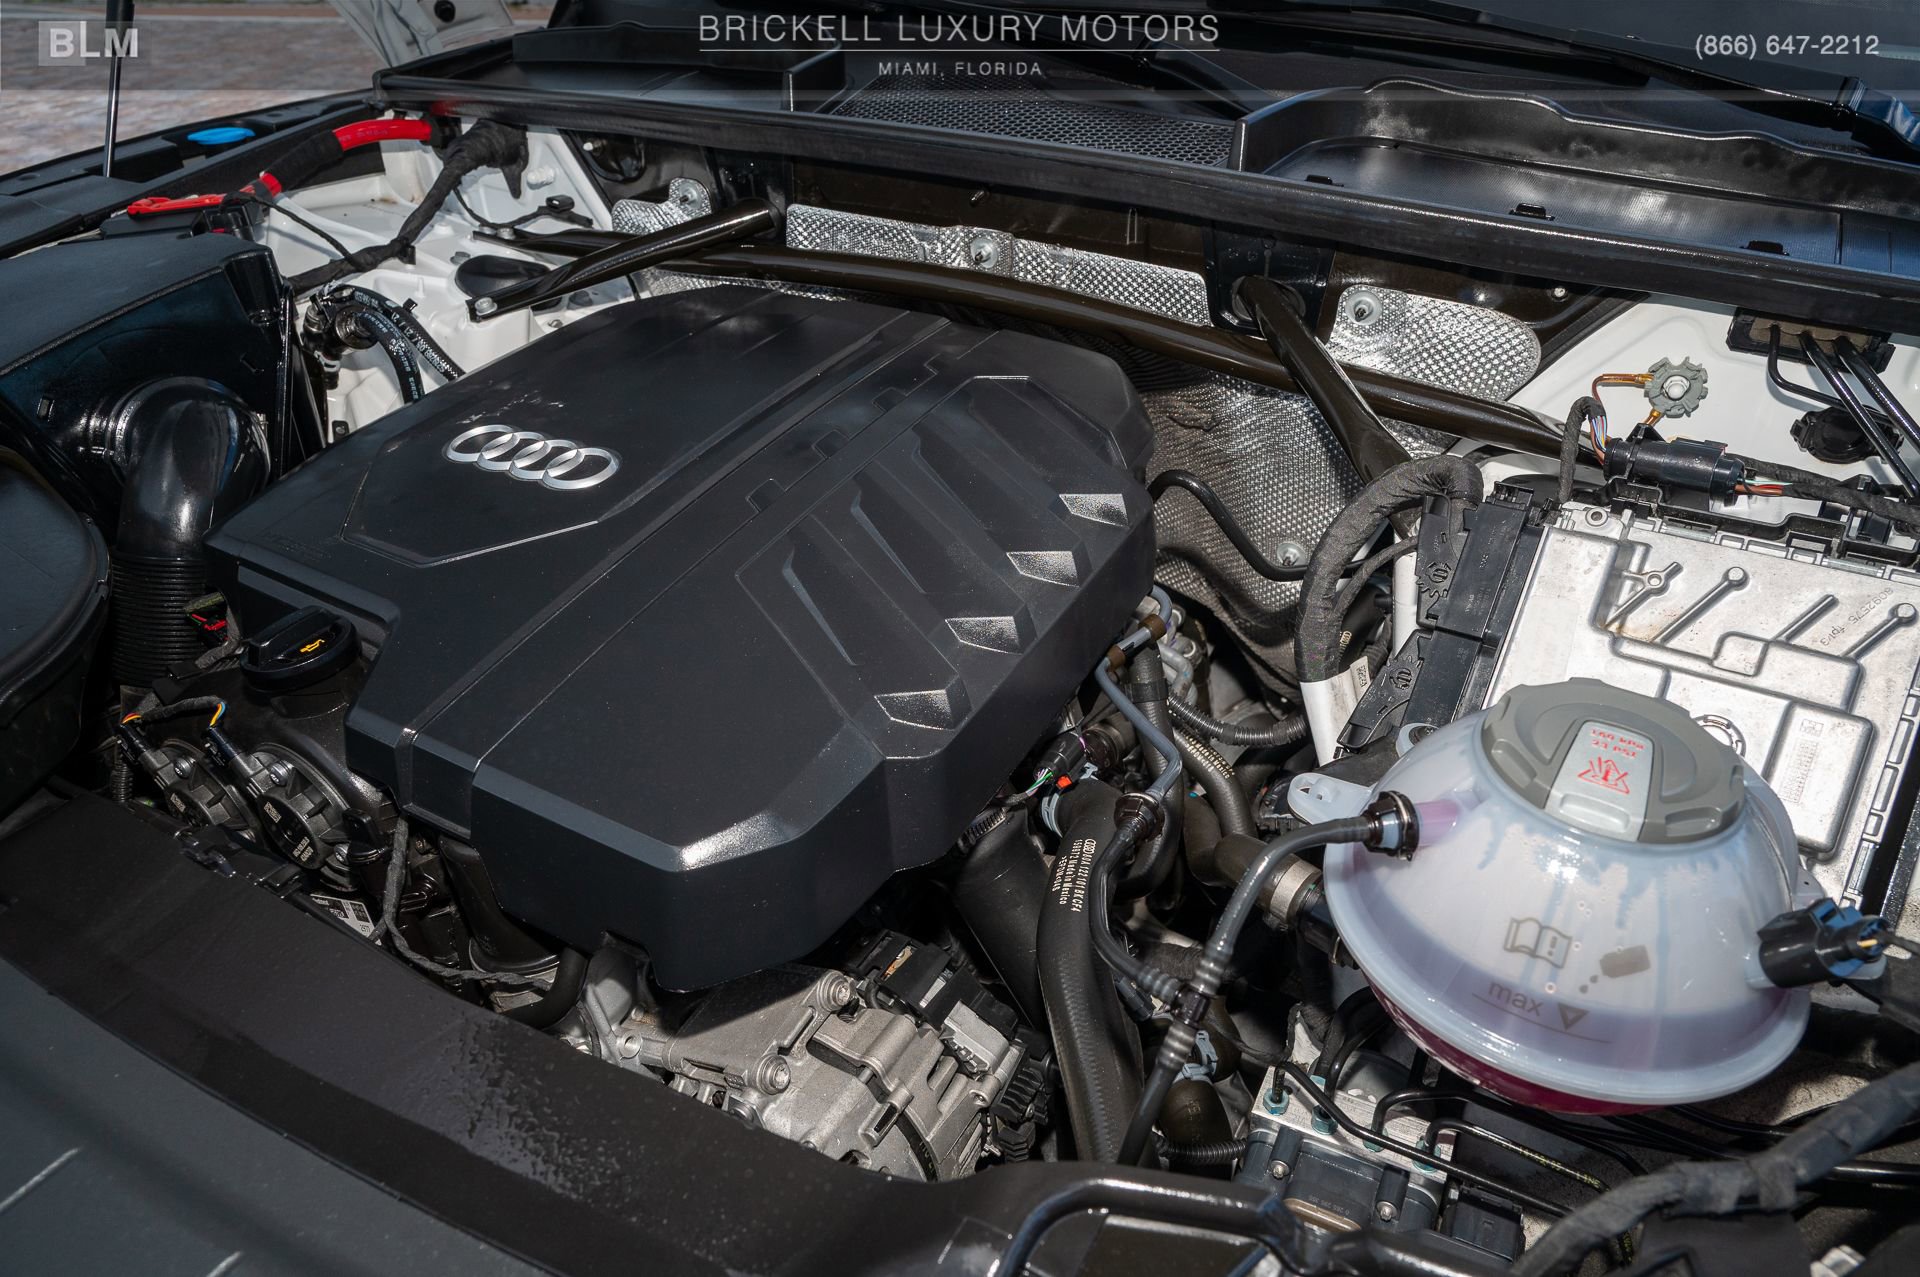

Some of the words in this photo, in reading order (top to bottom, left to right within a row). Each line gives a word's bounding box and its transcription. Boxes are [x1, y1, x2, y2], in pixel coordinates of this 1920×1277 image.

[1066, 860, 1078, 875] Made
[1059, 882, 1073, 905] Mexico
[1488, 981, 1544, 1017] max
